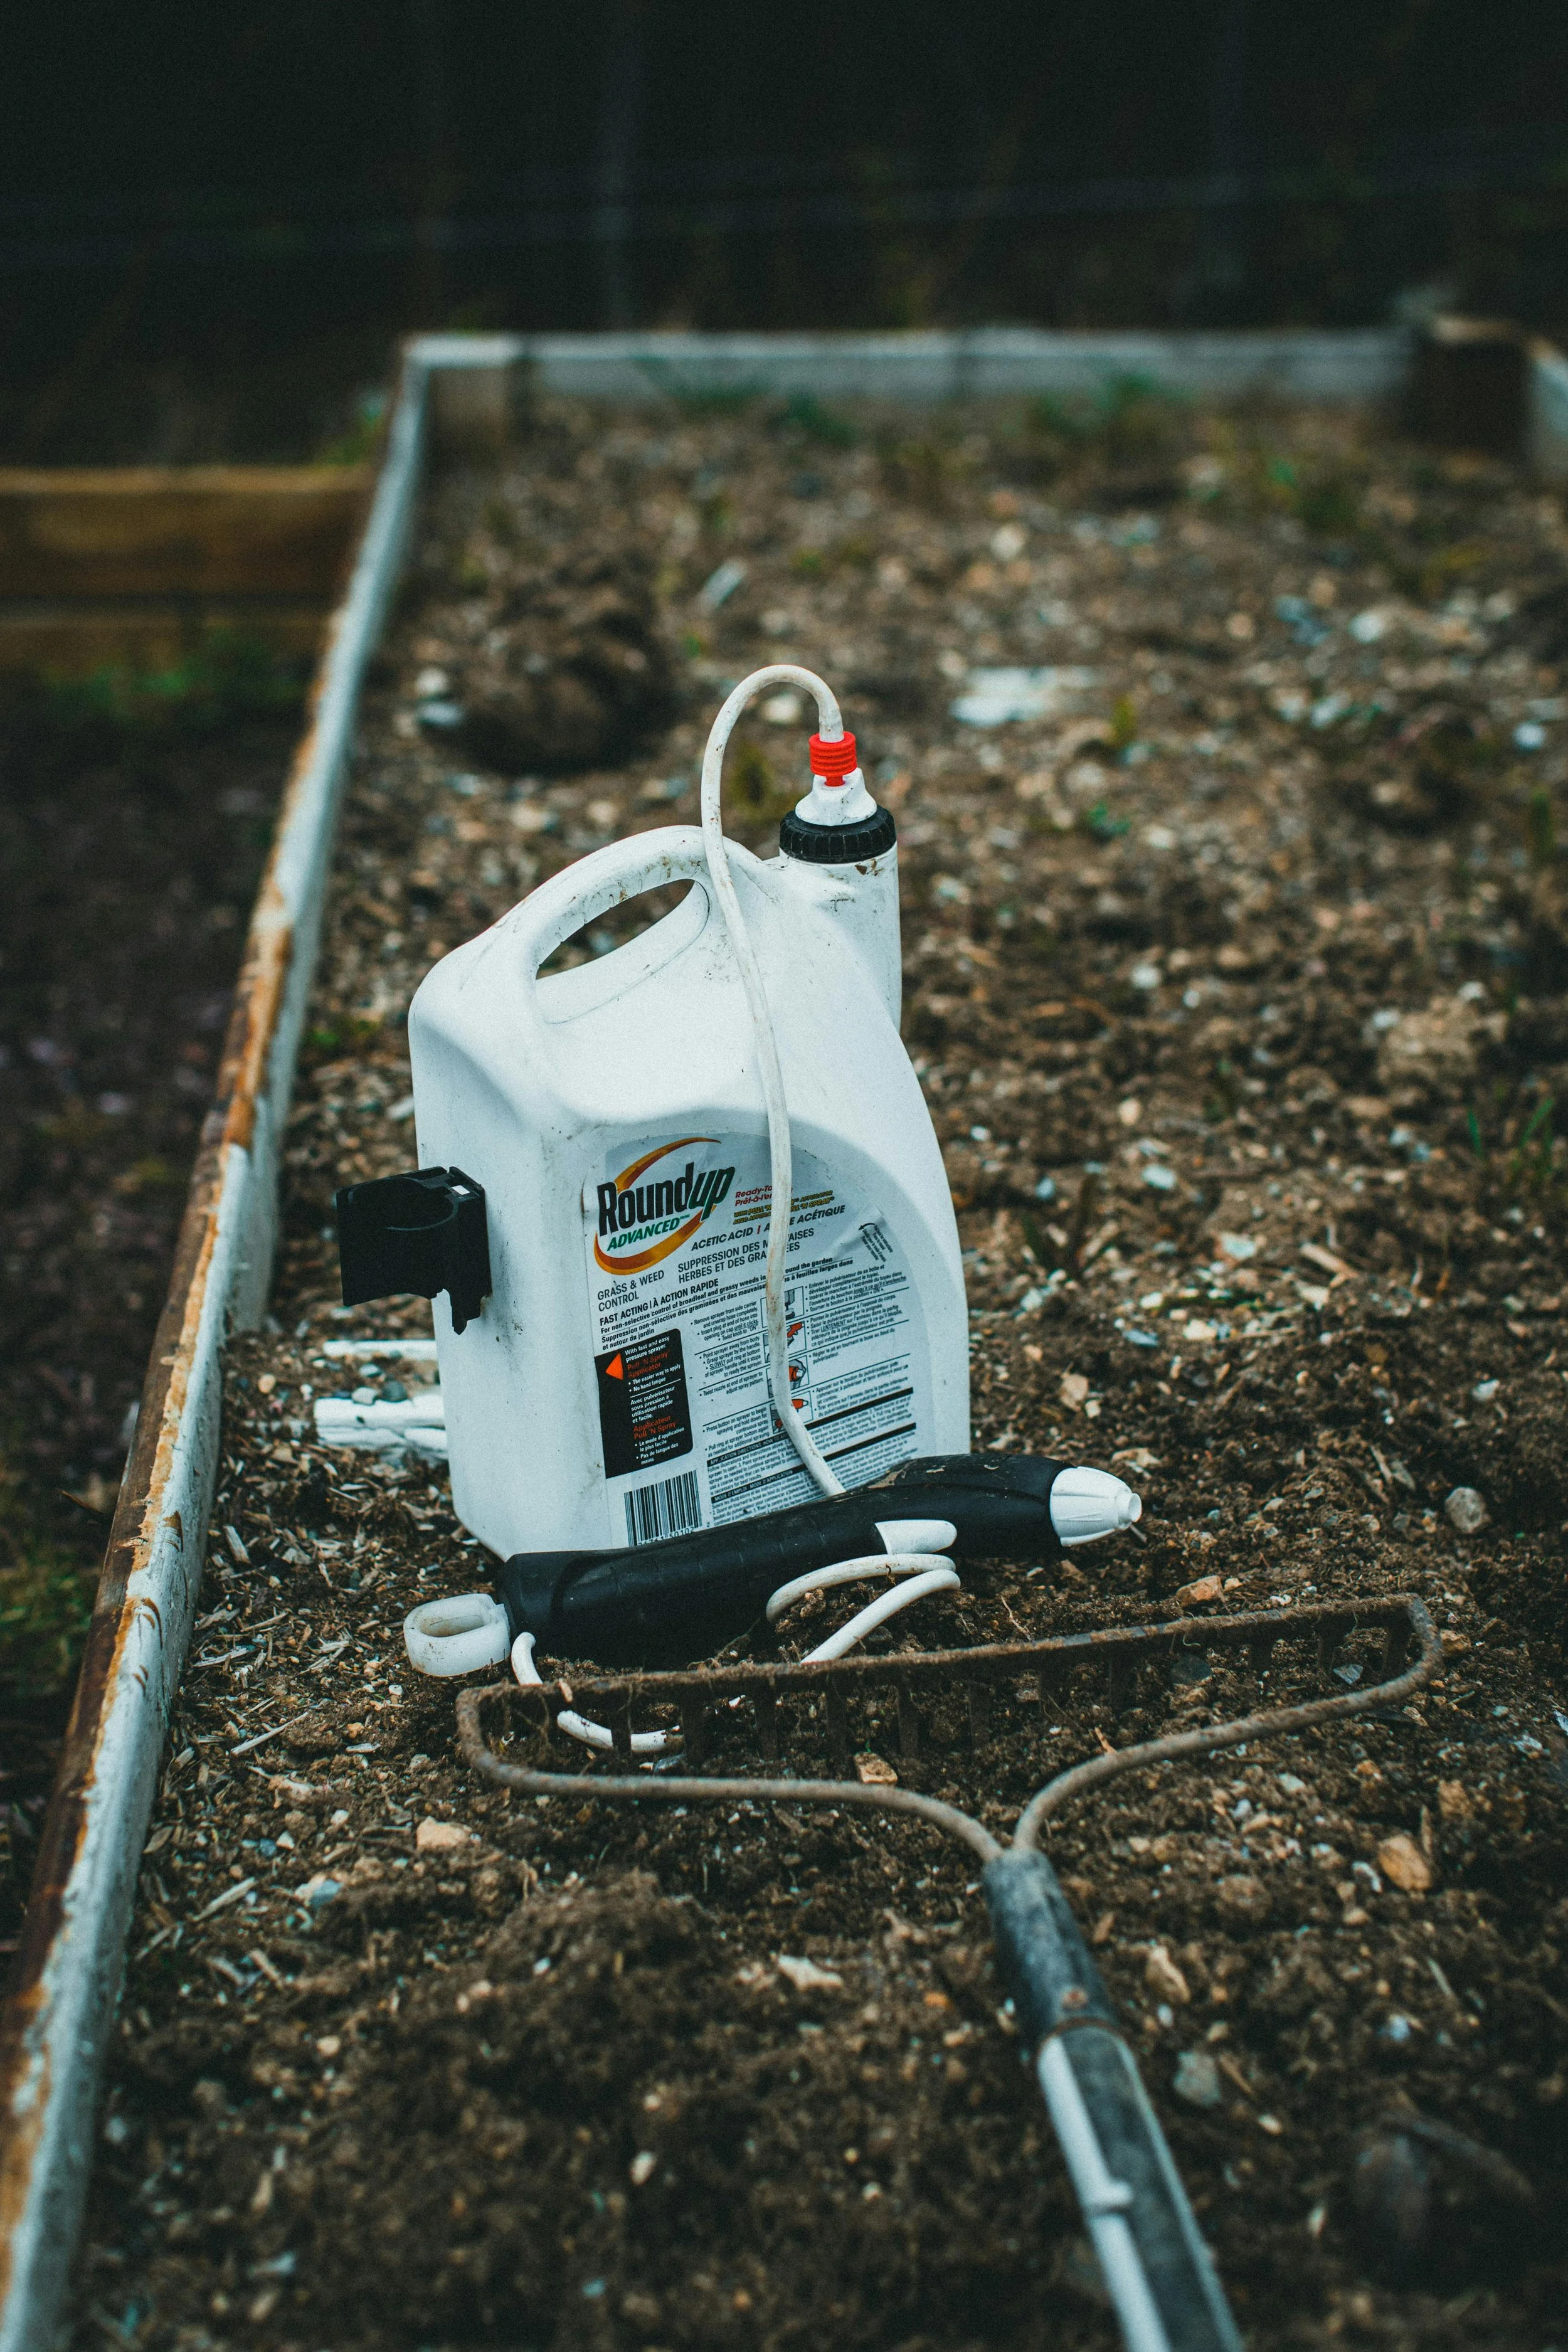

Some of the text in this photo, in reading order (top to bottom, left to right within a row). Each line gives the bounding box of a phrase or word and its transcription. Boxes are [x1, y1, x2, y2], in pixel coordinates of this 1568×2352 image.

[735, 1185, 771, 1197] Ready-To
[596, 1162, 734, 1236] Roundup
[748, 1205, 764, 1215] PULL
[607, 1218, 679, 1251] ADVANCED
[691, 1205, 845, 1251] ACETIC ACID ACÉTIQUE
[678, 1247, 739, 1272] SUPPRESSION
[743, 1241, 759, 1253] DES
[679, 1266, 712, 1283] HERBES
[715, 1261, 724, 1272] ET
[728, 1256, 744, 1268] DES
[598, 1270, 664, 1300] GRASS & WEED
[598, 1291, 638, 1311] CONTROL
[612, 1313, 650, 1330] non-selective
[651, 1304, 670, 1316] control
[679, 1291, 706, 1306] broadleaf
[707, 1288, 718, 1296] and
[719, 1283, 738, 1294] grassy
[739, 1276, 758, 1286] weeds
[812, 1258, 832, 1267] garden
[600, 1278, 718, 1326] FAST ACTING À ACTION RAPIDE
[601, 1327, 637, 1343] Suppression
[638, 1313, 676, 1330] non-sélective
[689, 1298, 718, 1313] graminées
[796, 1269, 818, 1278] feuilles
[818, 1264, 837, 1272] larges
[694, 1316, 709, 1325] Remove
[711, 1317, 726, 1325] unwrap
[610, 1338, 628, 1347] autour
[638, 1328, 654, 1339] jardin
[704, 1332, 719, 1340] opening
[733, 1328, 742, 1337] knob
[626, 1344, 665, 1362] pressure sprayer.
[714, 1347, 728, 1355] sprayer
[719, 1351, 733, 1359] sprayer
[627, 1362, 639, 1370] Pull
[628, 1363, 660, 1377] Applicator
[709, 1367, 723, 1375] sprayer
[644, 1386, 674, 1401] pulvérisateur
[632, 1400, 672, 1417] utilisation rapide
[644, 1397, 664, 1407] pression
[633, 1416, 670, 1431] Applicateur
[634, 1429, 647, 1439] Pull
[658, 1428, 684, 1439] d'application
